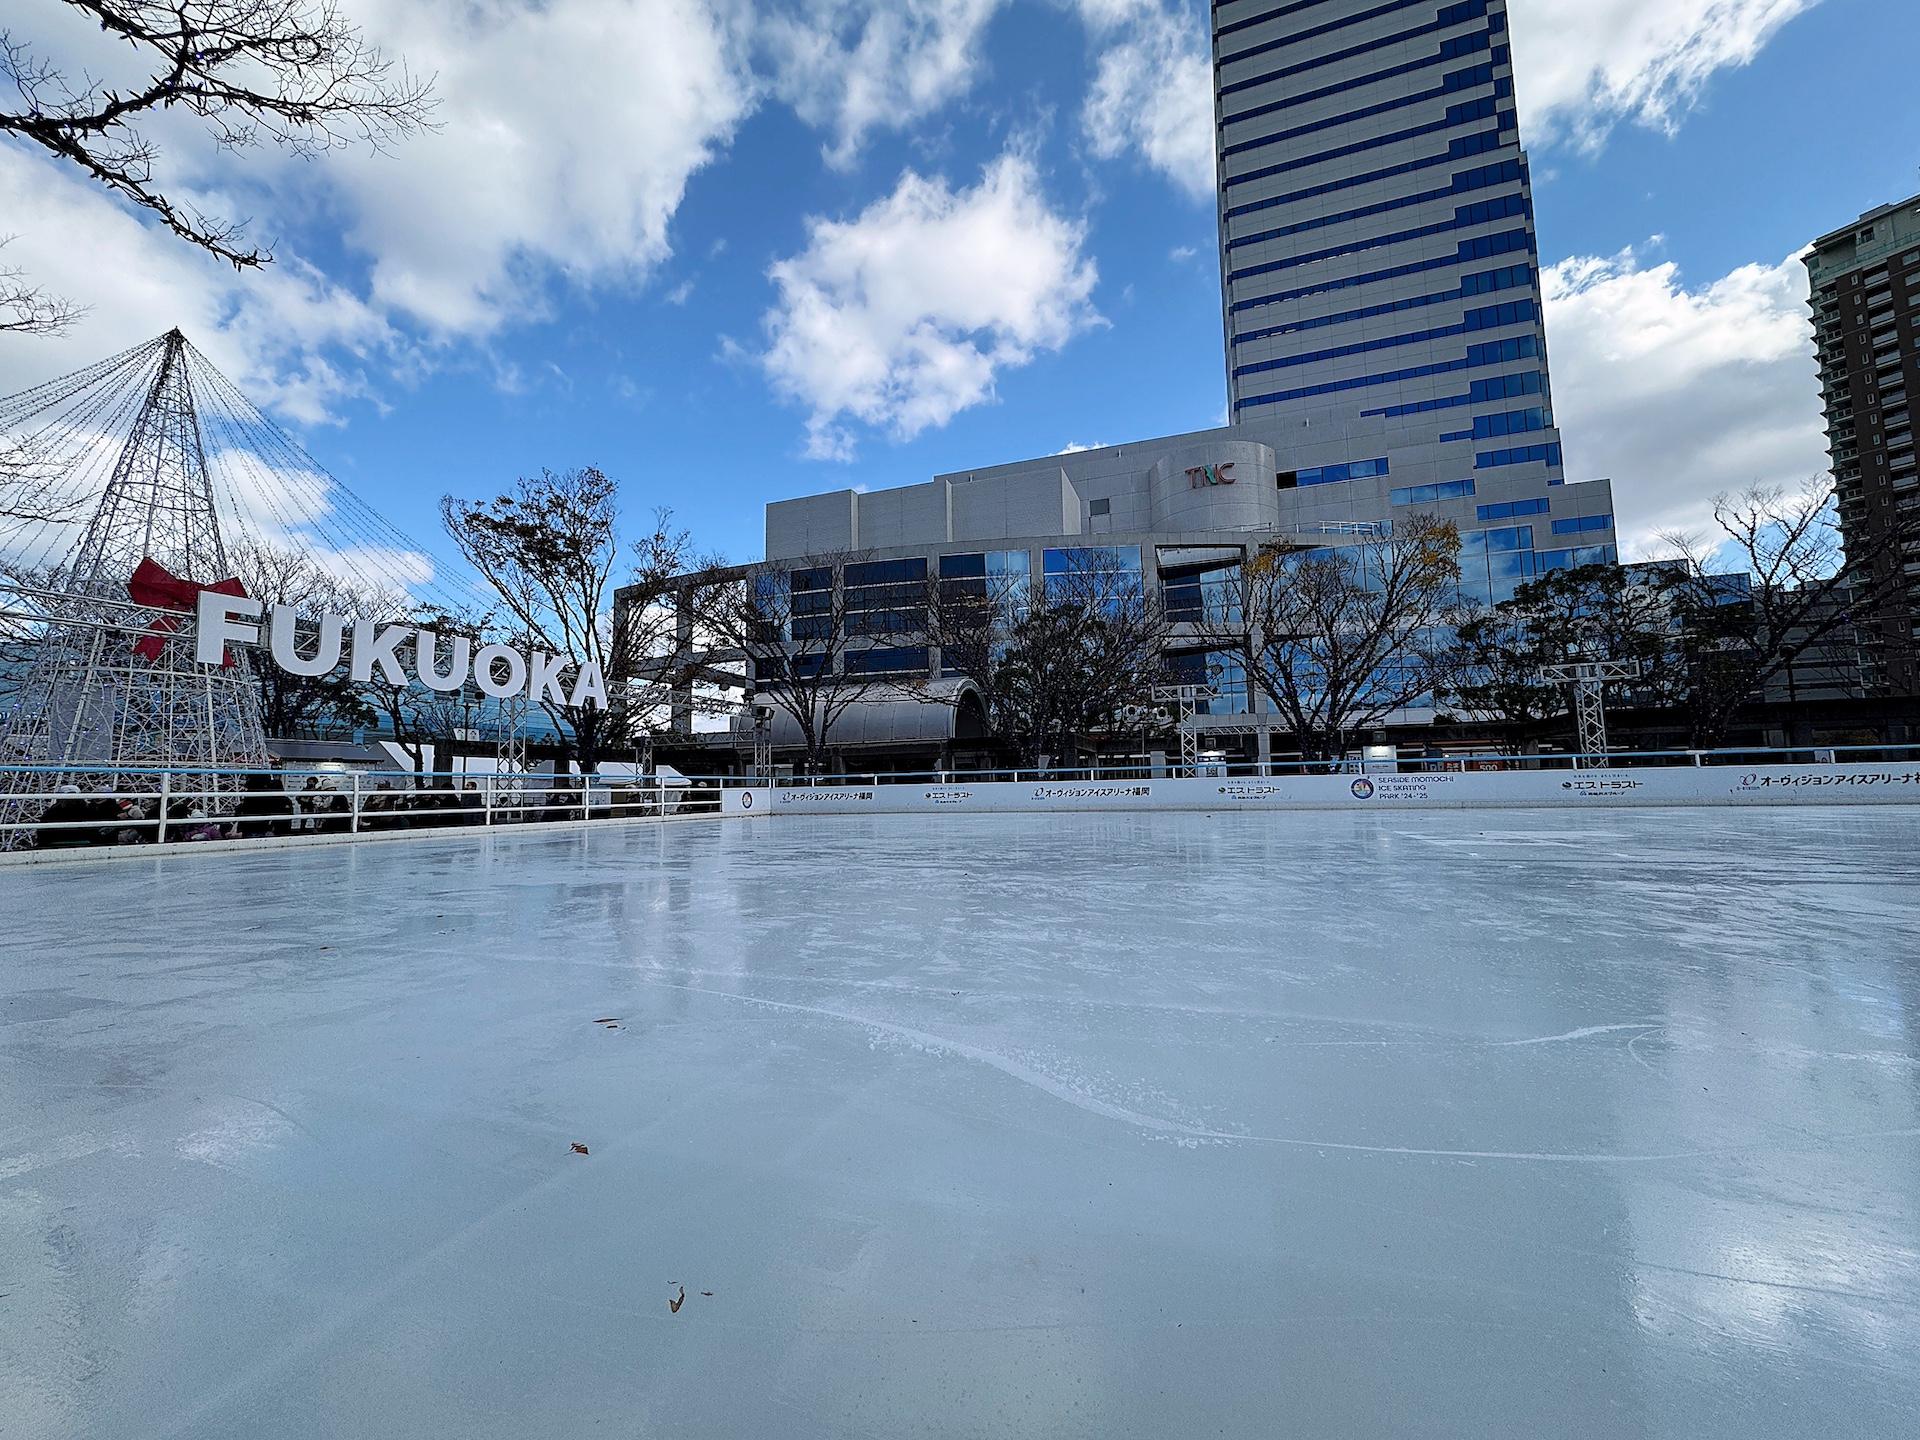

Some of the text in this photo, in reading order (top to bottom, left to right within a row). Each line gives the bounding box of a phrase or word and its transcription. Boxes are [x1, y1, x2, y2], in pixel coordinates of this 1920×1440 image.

[1185, 462, 1236, 489] TNC
[197, 590, 608, 709] FUKUOKA
[1378, 776, 1409, 784] SEASIDE
[1378, 784, 1427, 792] ICE SKATING
